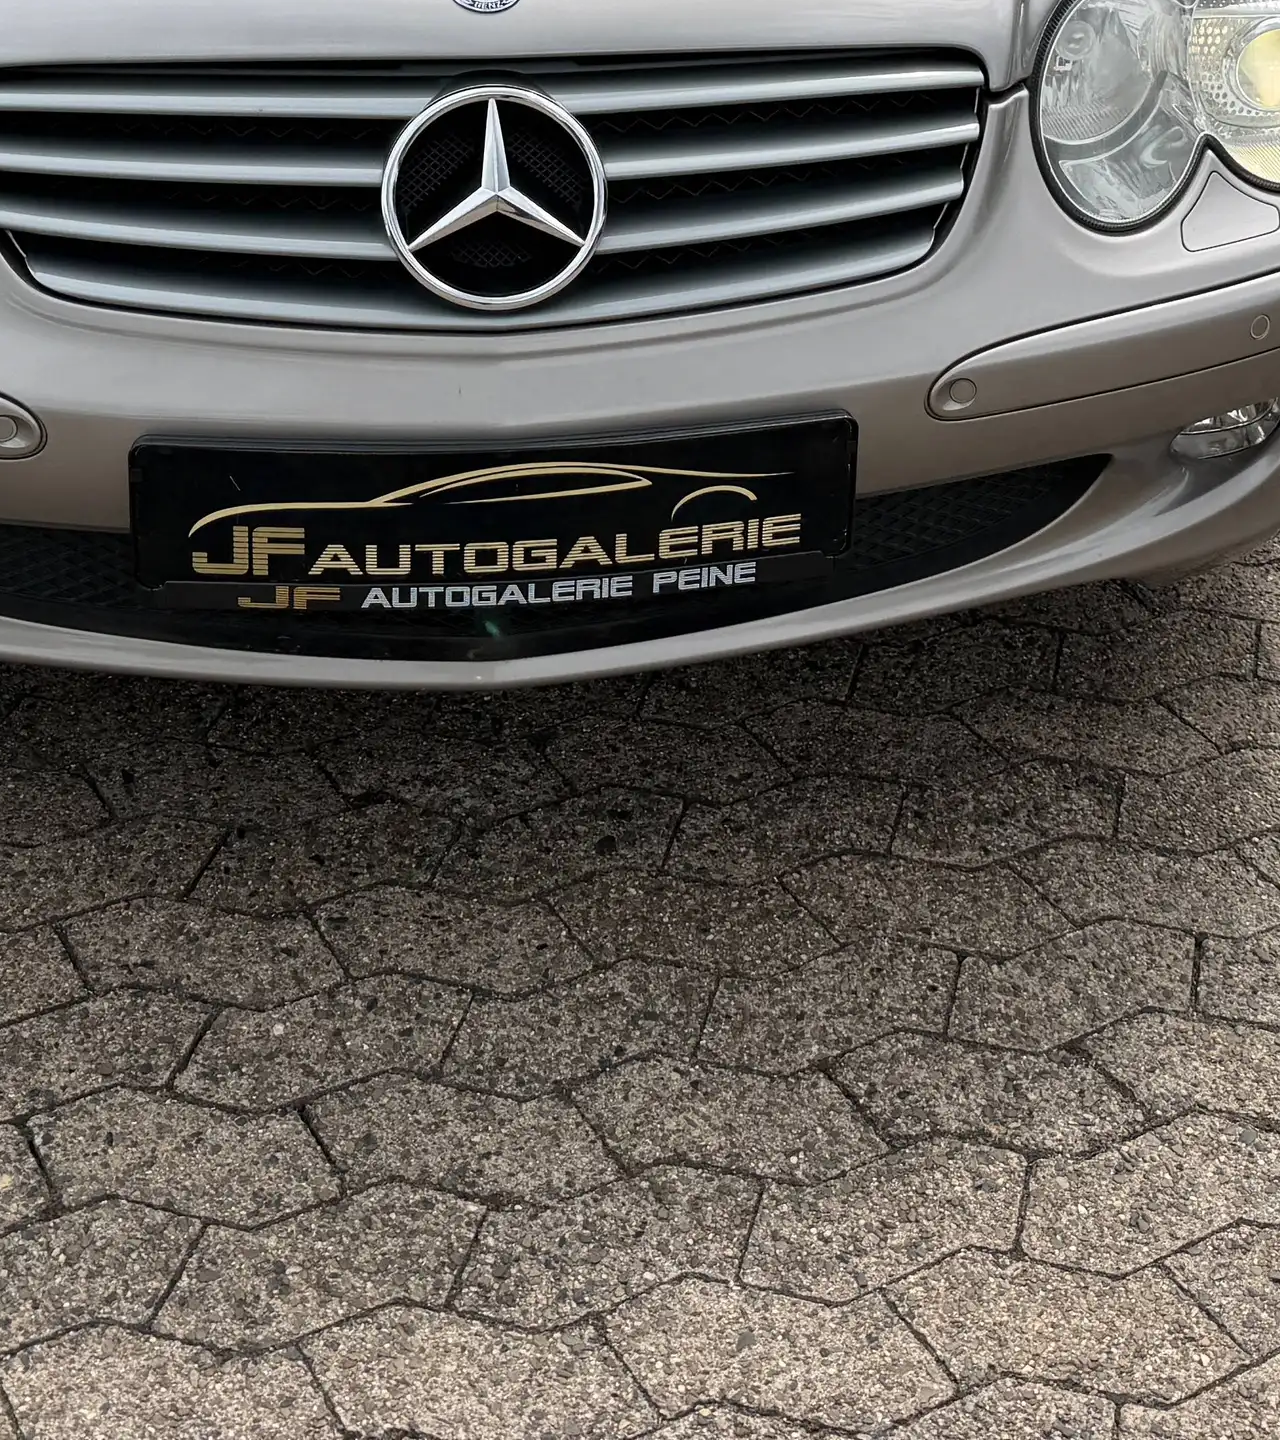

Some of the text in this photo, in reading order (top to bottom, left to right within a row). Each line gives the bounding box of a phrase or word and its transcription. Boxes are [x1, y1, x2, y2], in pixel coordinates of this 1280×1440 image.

[192, 513, 803, 576] JF AUTOGALERIE
[237, 562, 757, 609] JF AUTOGALERIE PEINE
